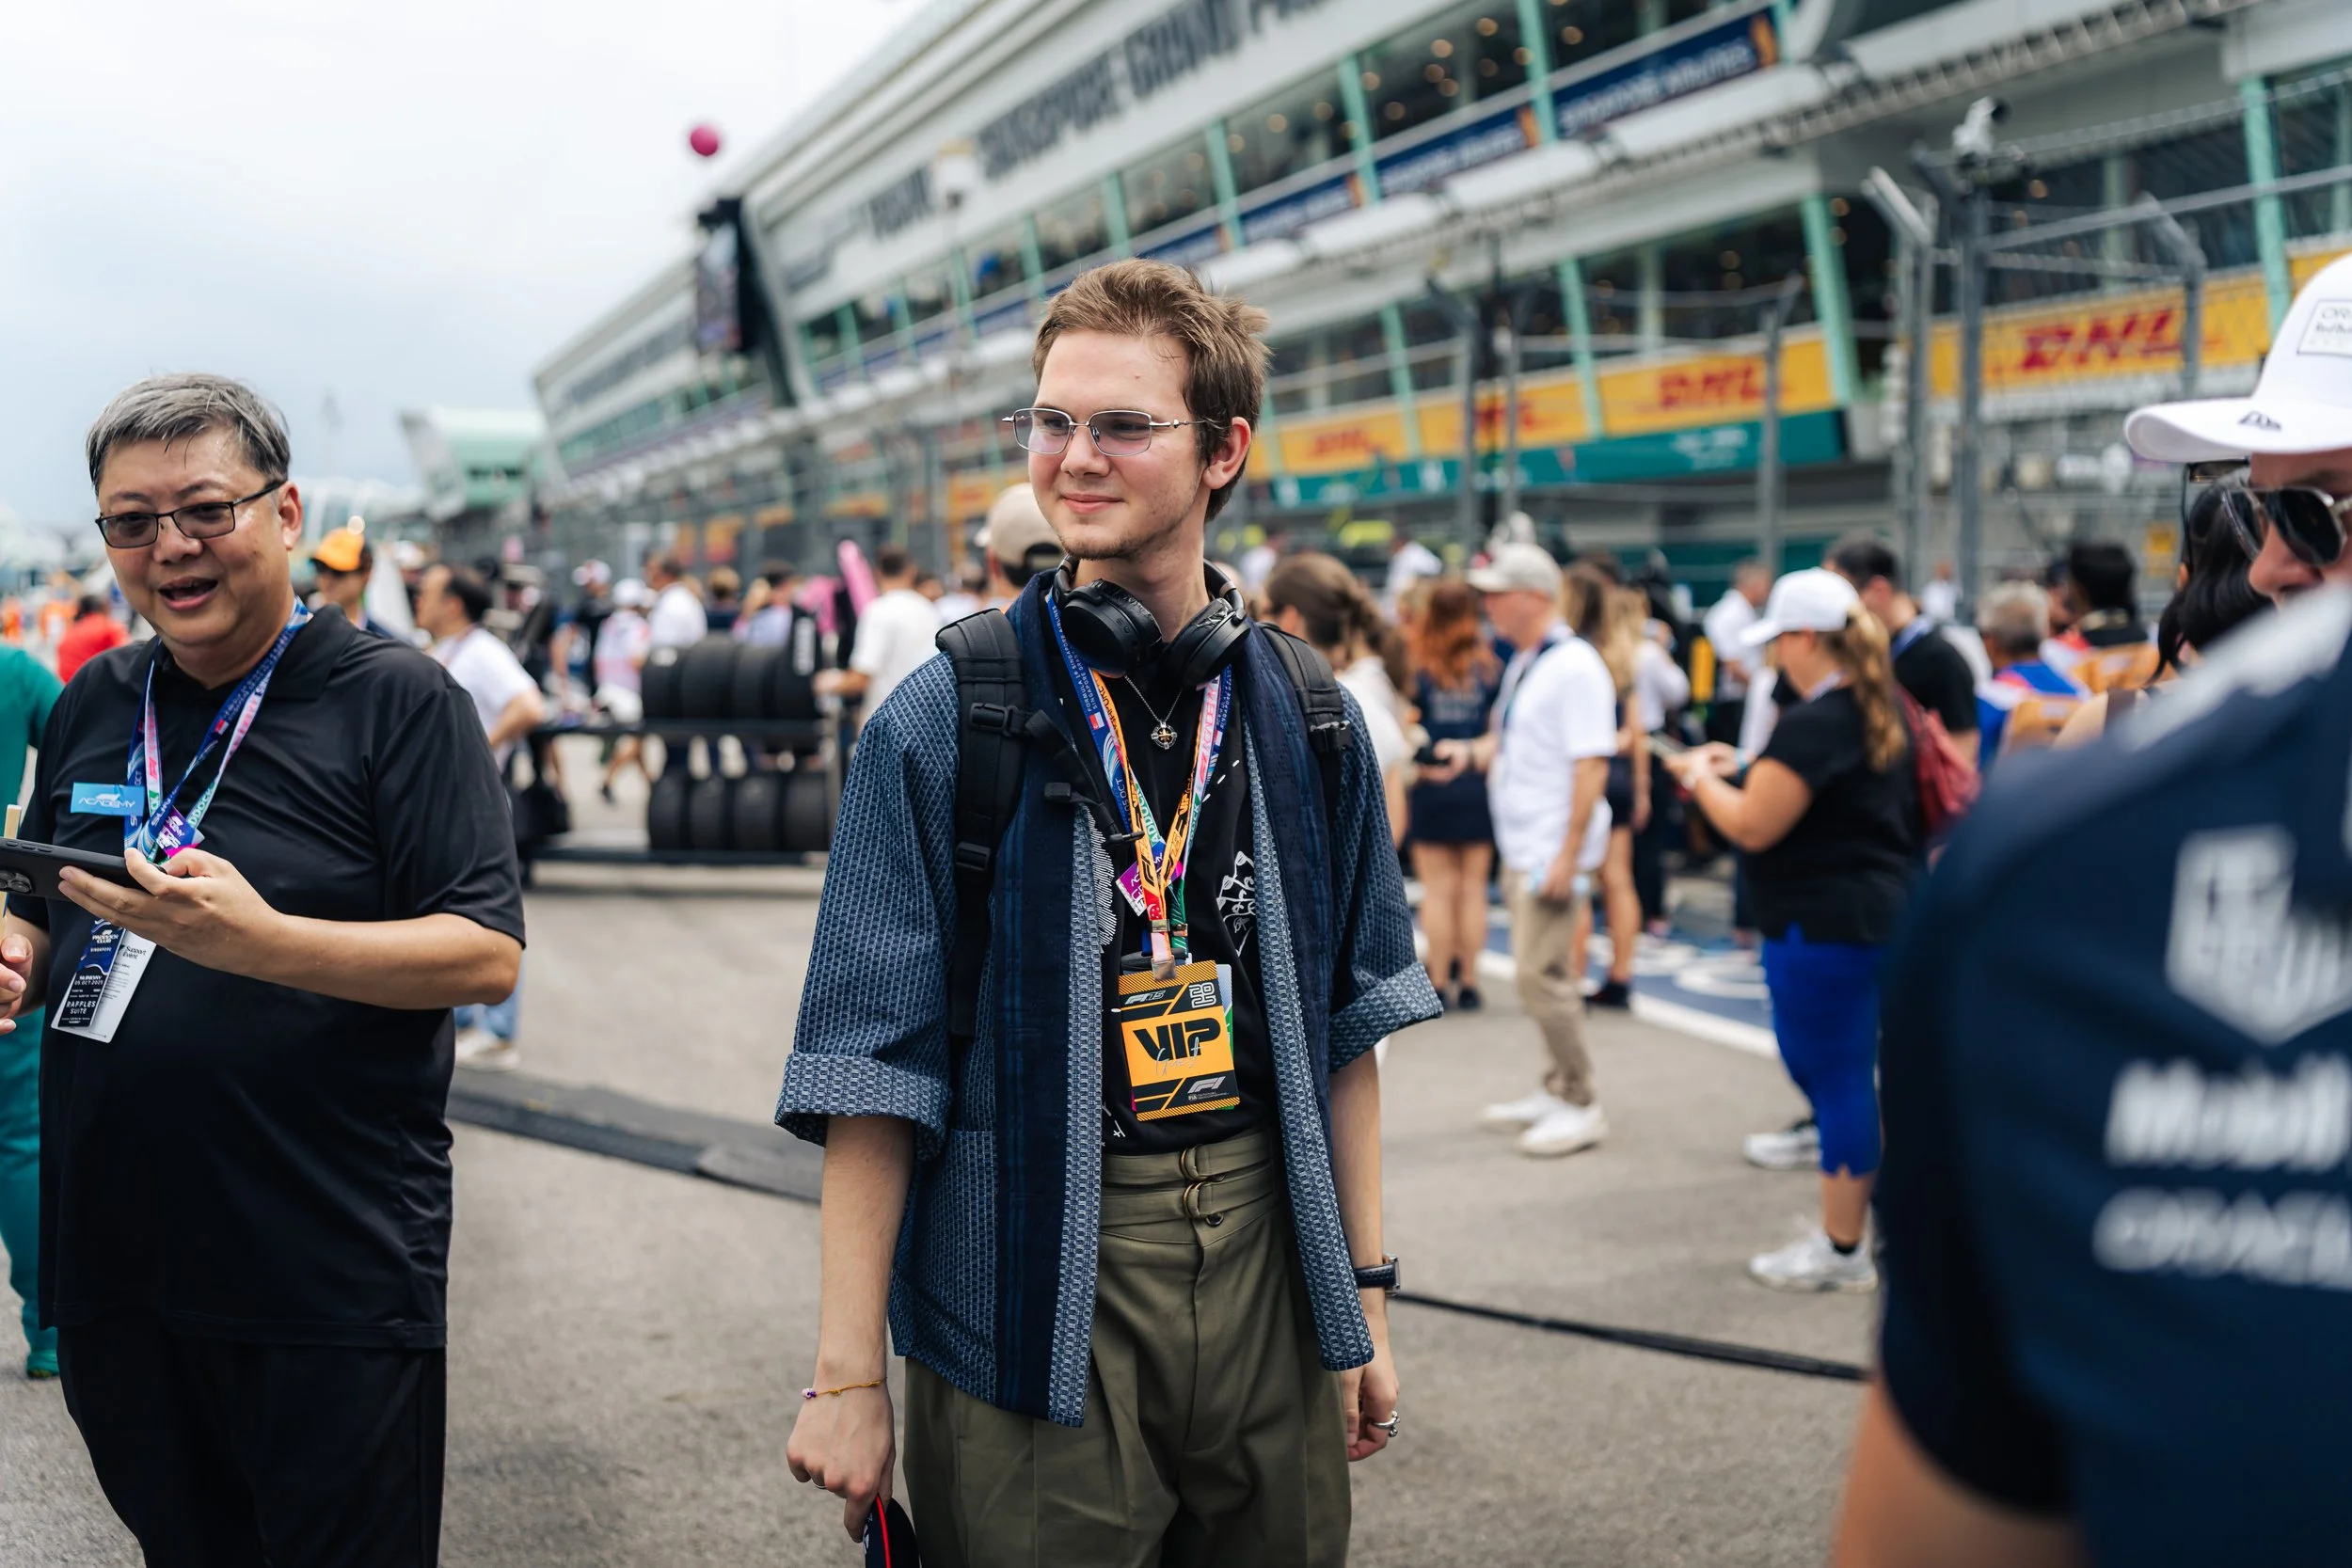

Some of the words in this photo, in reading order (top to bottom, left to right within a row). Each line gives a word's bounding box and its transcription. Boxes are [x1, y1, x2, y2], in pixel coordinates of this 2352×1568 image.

[2020, 307, 2185, 371] DHL
[1052, 605, 1063, 633] AIRLINES
[1060, 635, 1076, 669] SINGAPORE
[1077, 681, 1091, 712] FORMULA
[1081, 673, 1098, 709] SINGAPORE
[78, 797, 136, 808] ACADEMY
[122, 952, 138, 960] Event
[126, 945, 147, 956] Support
[1133, 1018, 1221, 1062] VIP
